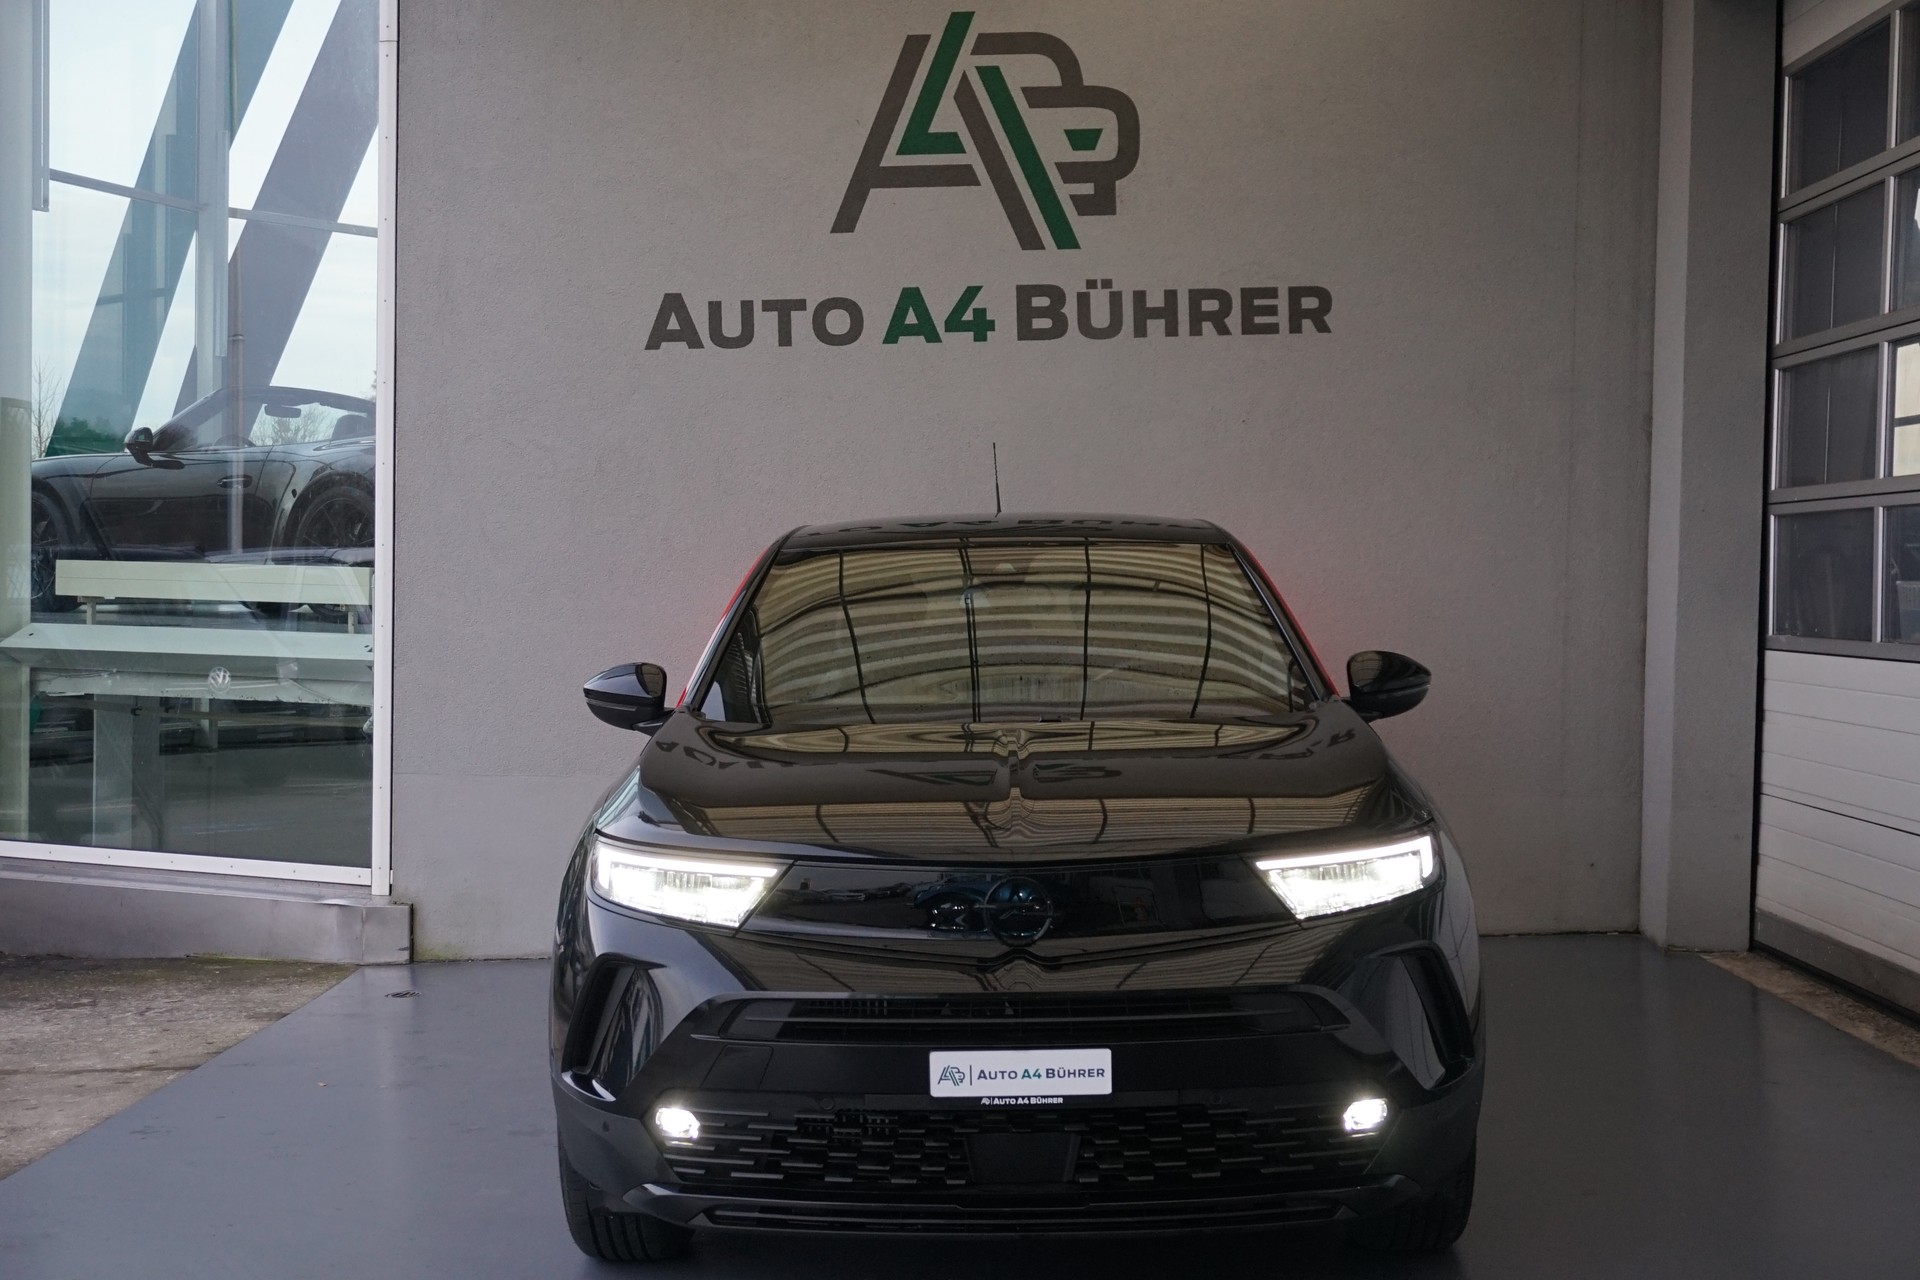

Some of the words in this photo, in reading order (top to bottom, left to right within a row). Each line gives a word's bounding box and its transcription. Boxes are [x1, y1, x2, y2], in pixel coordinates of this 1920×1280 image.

[644, 292, 865, 351] AUTO
[881, 285, 996, 345] A4
[1015, 278, 1333, 342] BÜHRER
[976, 1069, 1018, 1081] AUTO
[1021, 1068, 1043, 1080] A4
[1045, 1066, 1106, 1079] BÜHRER
[992, 1097, 1017, 1106] AUTO
[1016, 1096, 1030, 1105] A4
[1029, 1096, 1064, 1105] BÜHRER
